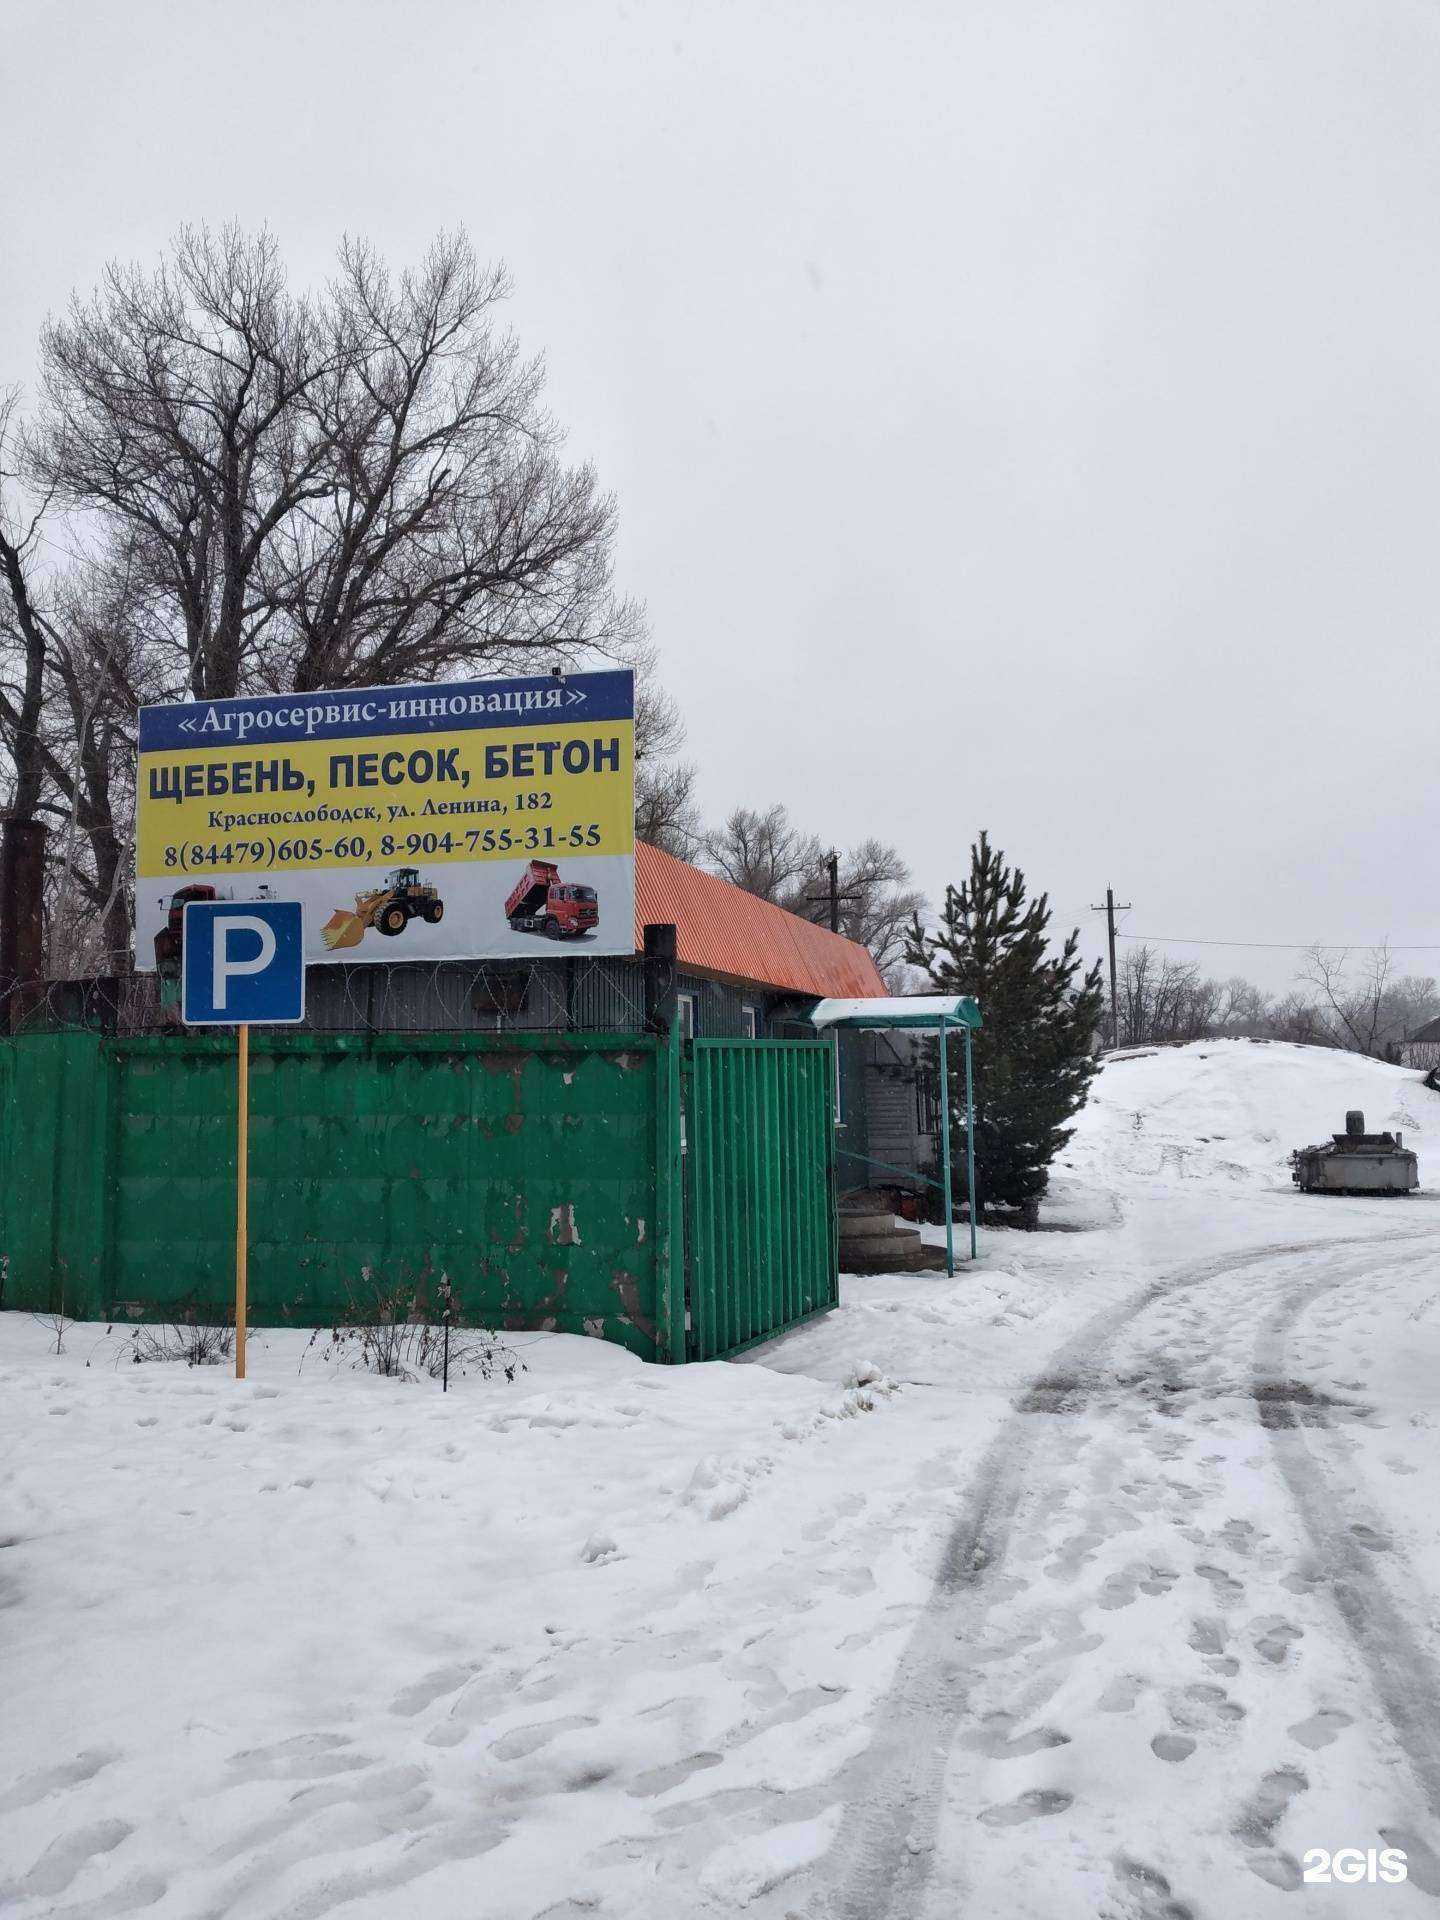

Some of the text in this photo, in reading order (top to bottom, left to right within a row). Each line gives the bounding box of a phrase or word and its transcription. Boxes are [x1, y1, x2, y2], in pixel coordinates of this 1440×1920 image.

[178, 687, 587, 739] «Агросервис-инновация»
[148, 737, 620, 804] ЩЕБЕНЬ, ПЕСОК, БЕТОН
[207, 792, 553, 830] Краснослободск, ул. Ленина, 182
[164, 824, 602, 871] 8(84479)605-60, 8-904-755-31-55
[212, 916, 277, 1010] P
